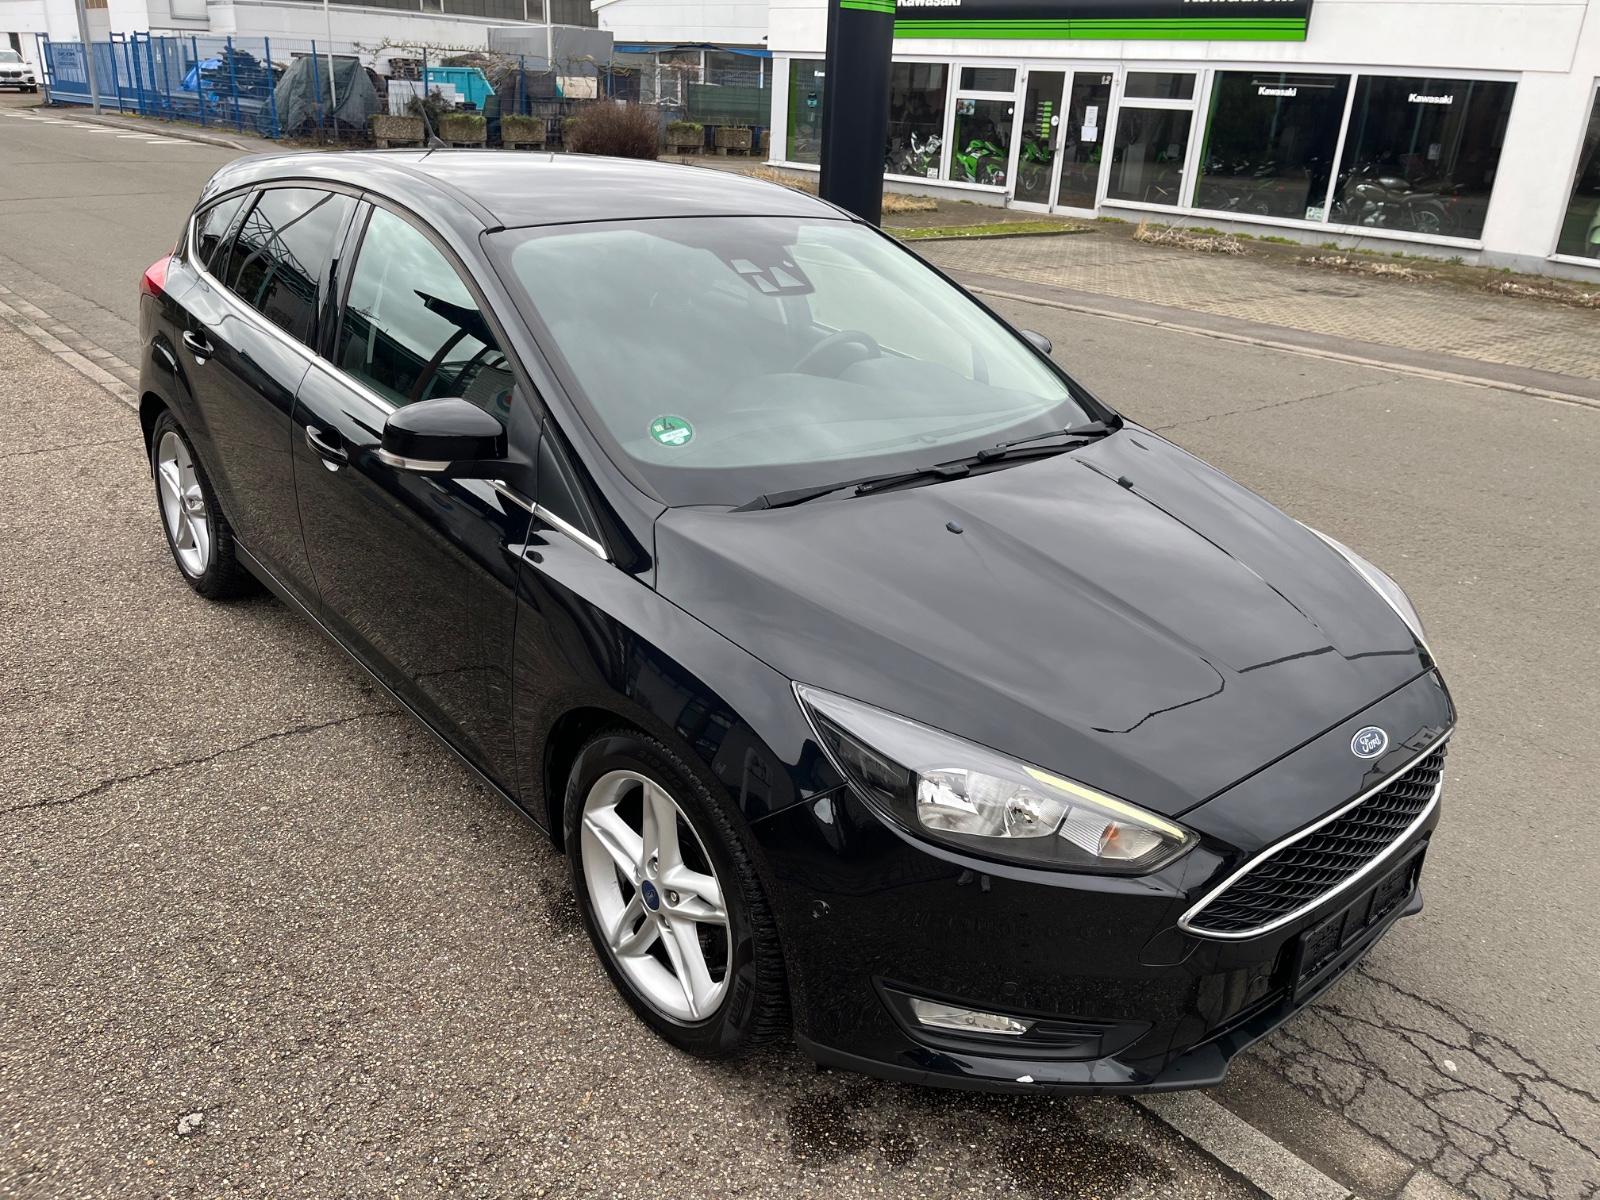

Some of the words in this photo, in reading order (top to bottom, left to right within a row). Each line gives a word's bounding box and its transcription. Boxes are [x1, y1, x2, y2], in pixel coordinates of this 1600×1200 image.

[1257, 86, 1298, 97] Kawasaki
[1408, 92, 1454, 105] Kawasaki
[1359, 733, 1382, 753] Ford
